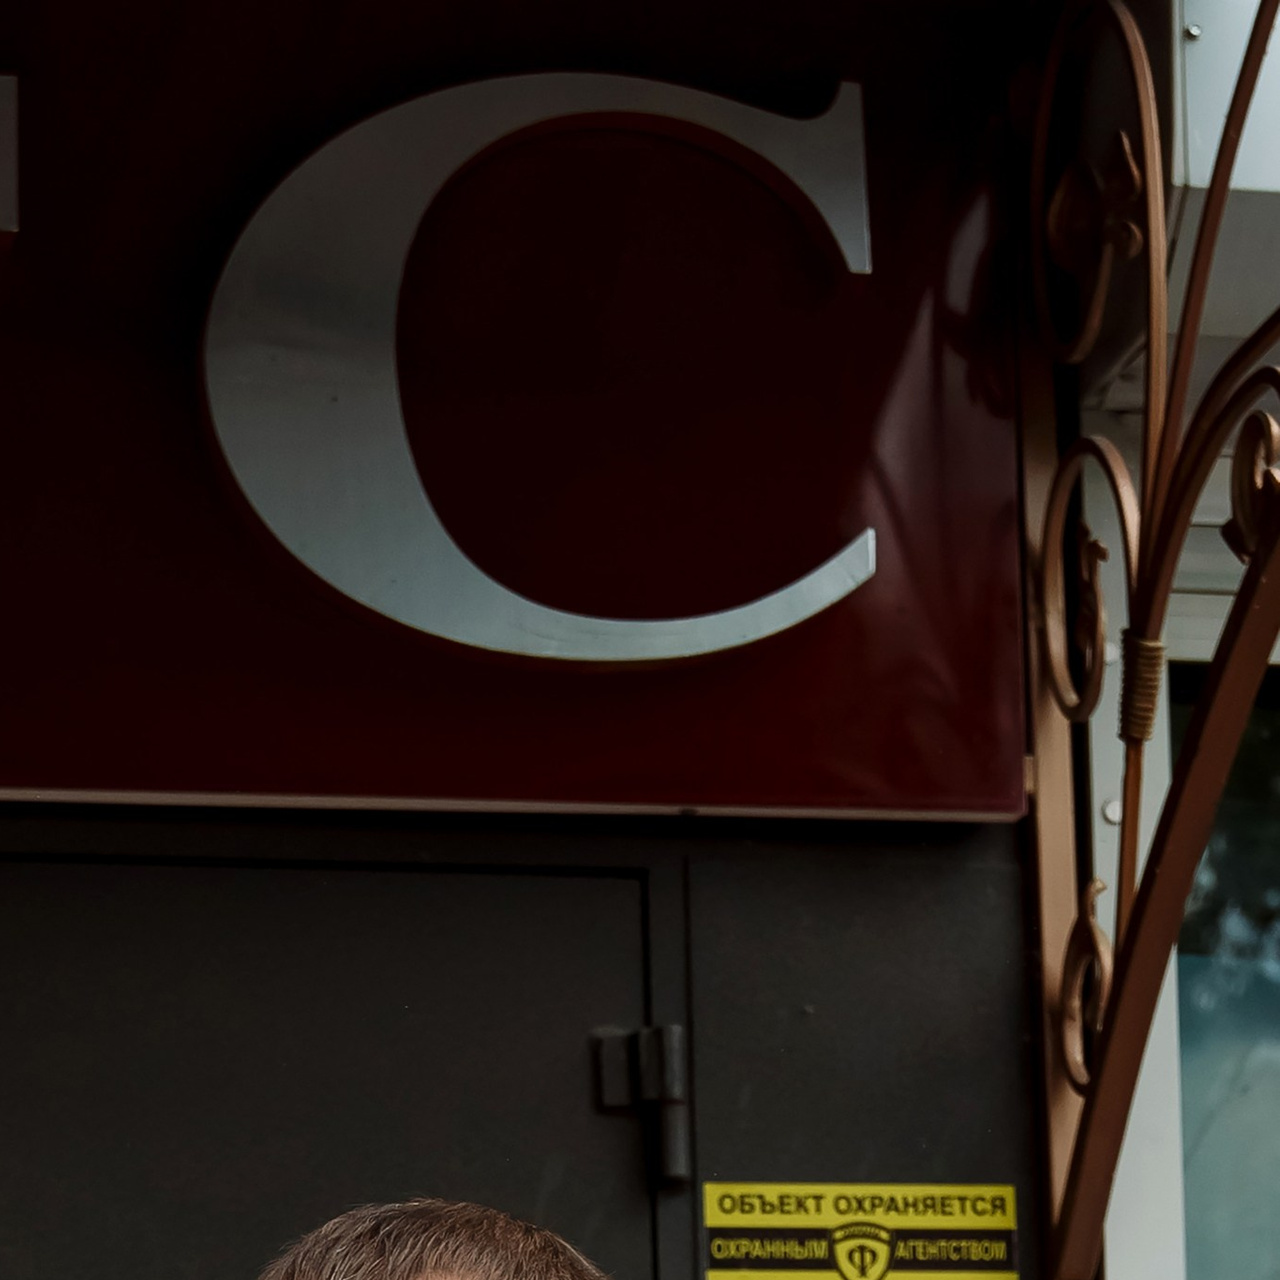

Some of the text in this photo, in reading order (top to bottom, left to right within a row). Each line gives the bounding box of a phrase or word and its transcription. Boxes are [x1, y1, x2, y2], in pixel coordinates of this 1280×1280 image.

[717, 1193, 1008, 1217] ОБЪЕКТ ОХРАНЯЕТСЯ
[711, 1238, 1007, 1260] ОХРАННЫМ АГЕНТСТВОМ
